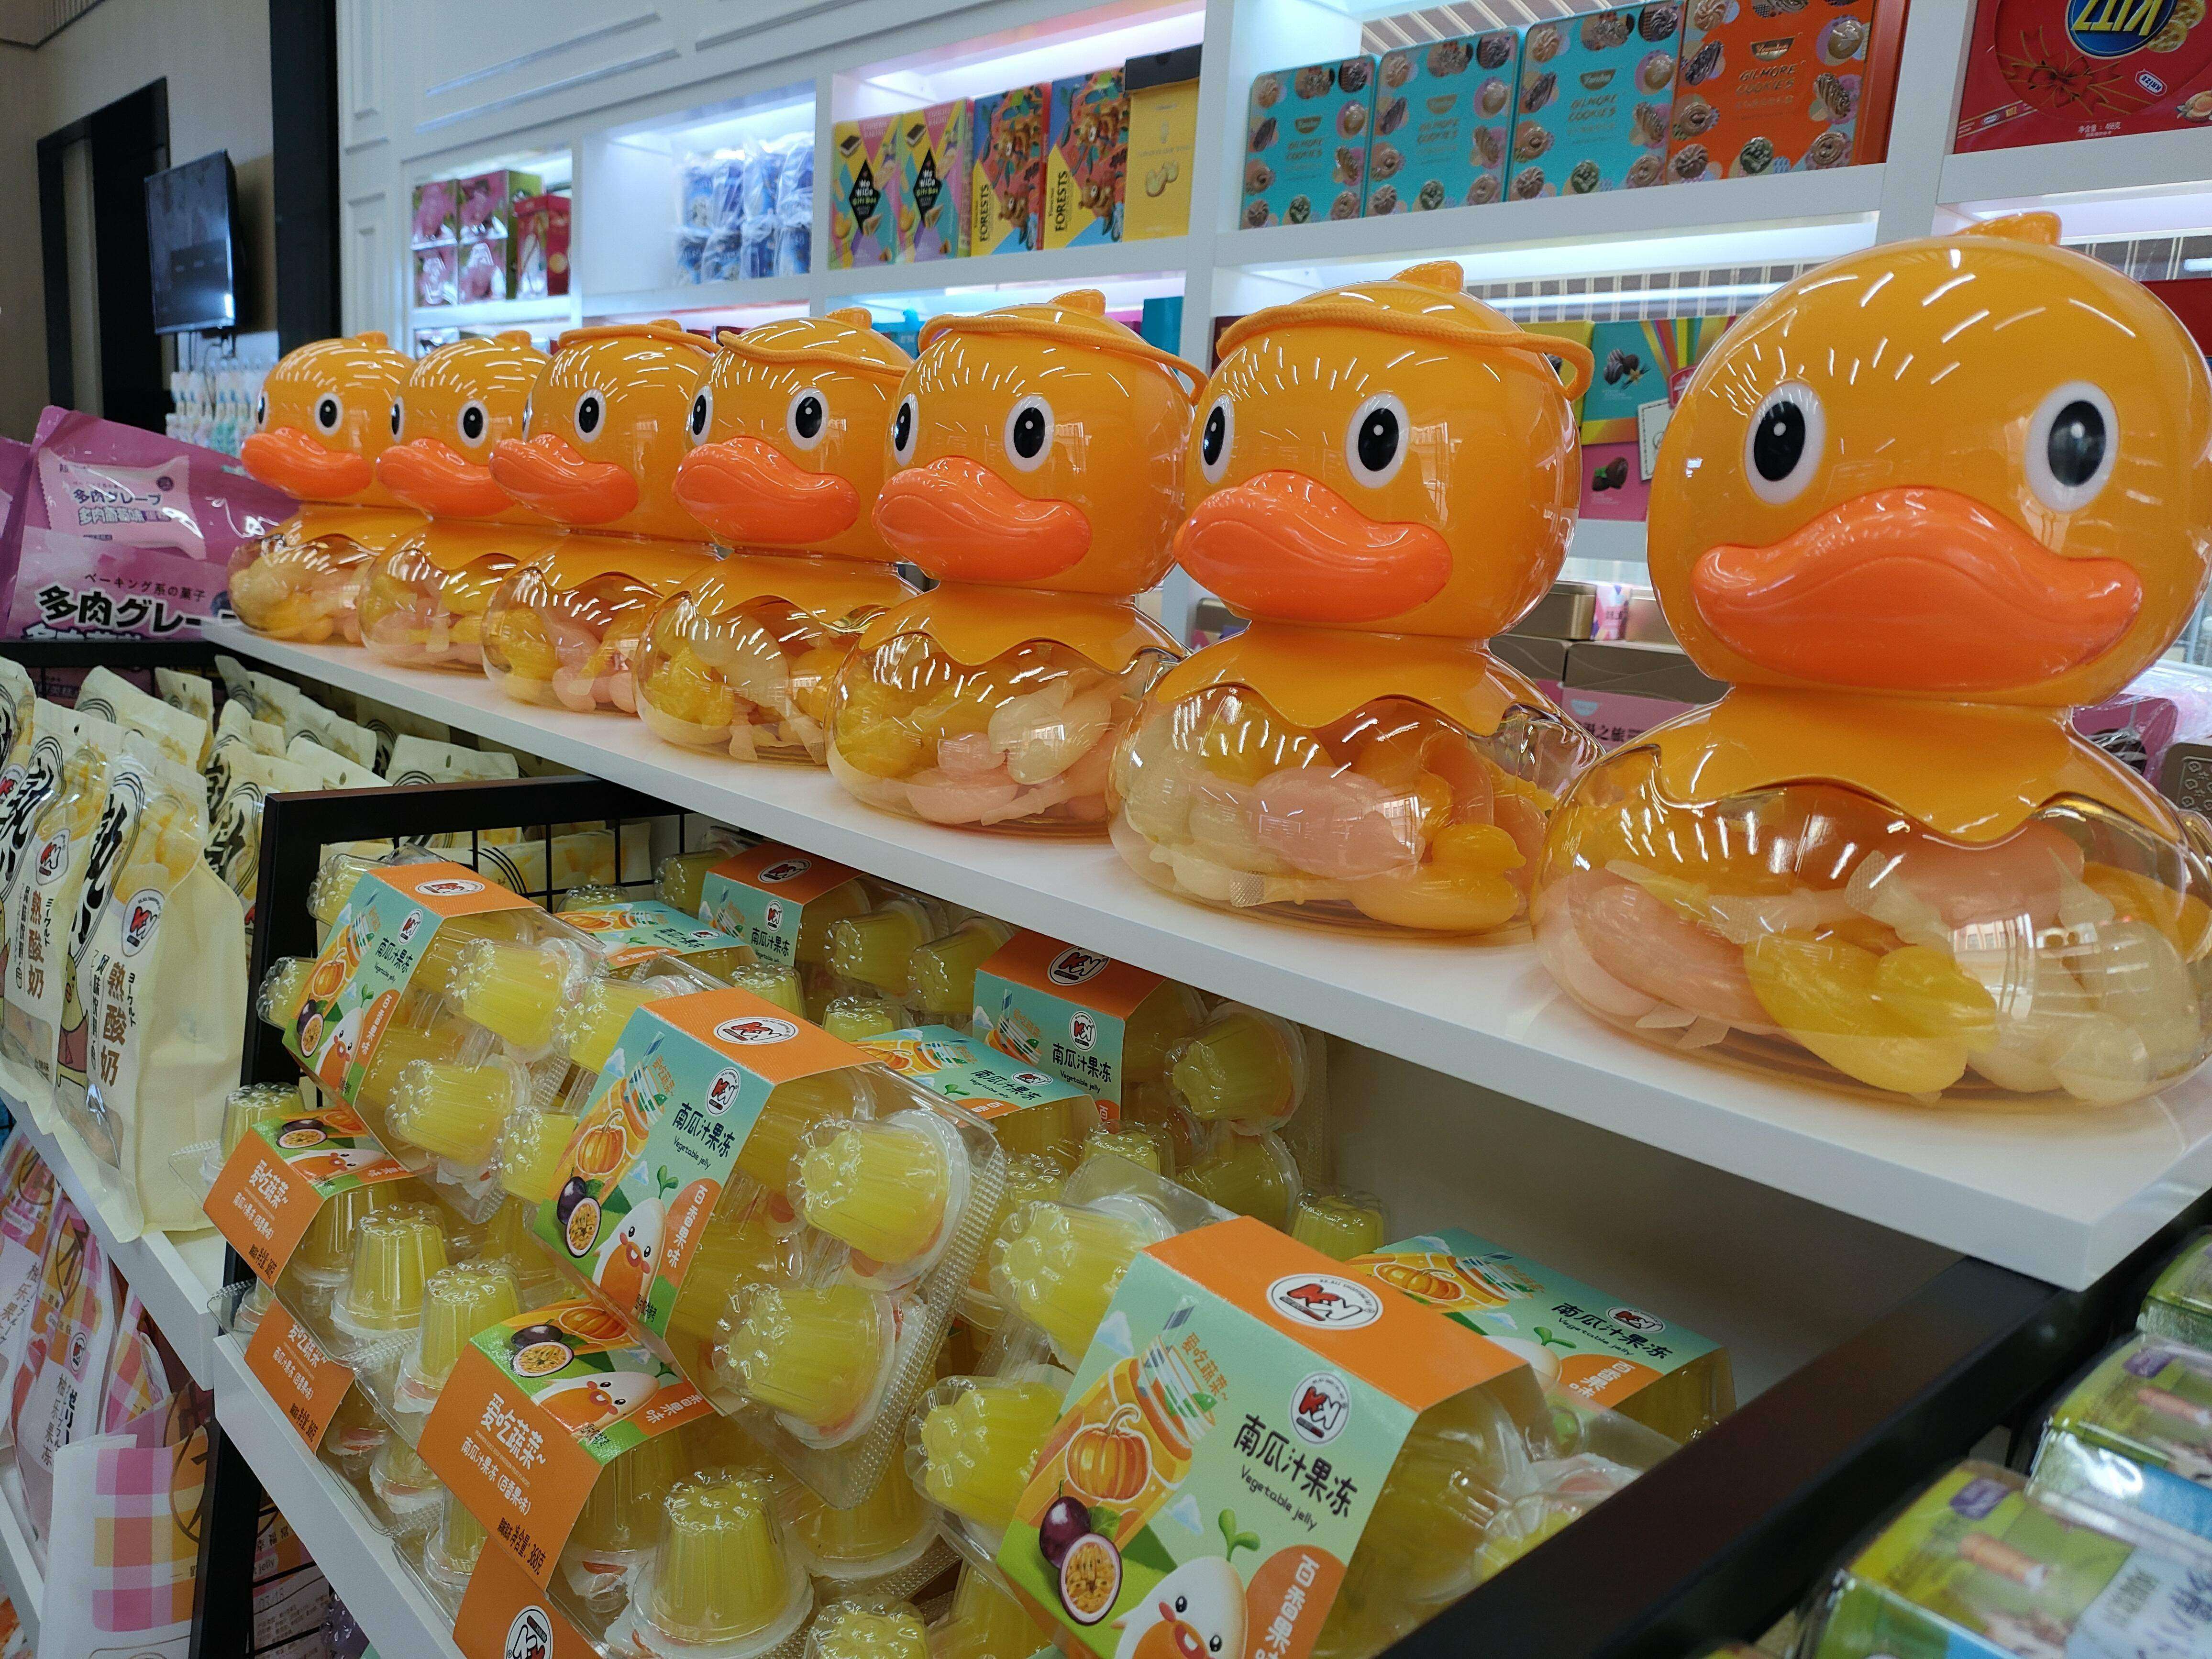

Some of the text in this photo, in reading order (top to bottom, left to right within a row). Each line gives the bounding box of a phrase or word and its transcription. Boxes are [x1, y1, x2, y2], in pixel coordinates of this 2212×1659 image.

[1739, 63, 1798, 82] GILMORE
[979, 183, 989, 242] FORESTS
[1055, 170, 1068, 232] FORESTS
[39, 585, 238, 633] 多肉グレー
[751, 927, 790, 957] 南瓜汁果冻
[100, 961, 127, 1087] 熟酸奶
[969, 1078, 998, 1093] Vegetable
[970, 1069, 1042, 1100] 南瓜汁果冻
[1052, 1042, 1111, 1083] 南瓜汁果冻
[1060, 1069, 1101, 1094] Vegetable jelly
[672, 1102, 735, 1158] 南瓜汁果冻
[673, 1135, 711, 1171] Vegetable jelly
[667, 1184, 708, 1269] 百香果味
[1551, 1302, 1673, 1360] 南瓜汁果冻
[1558, 1317, 1635, 1356] Vegetable jelly
[1182, 1332, 1228, 1401] 爱吃蔬菜~
[1569, 1360, 1636, 1398] 百香果味
[480, 1392, 546, 1471] 爱吃蔬菜~
[461, 1436, 499, 1482] 南瓜汁果冻
[497, 1474, 531, 1516] (百香果味)
[1233, 1413, 1358, 1518] 南瓜汁果冻
[1241, 1464, 1318, 1532] Vegetable jelly
